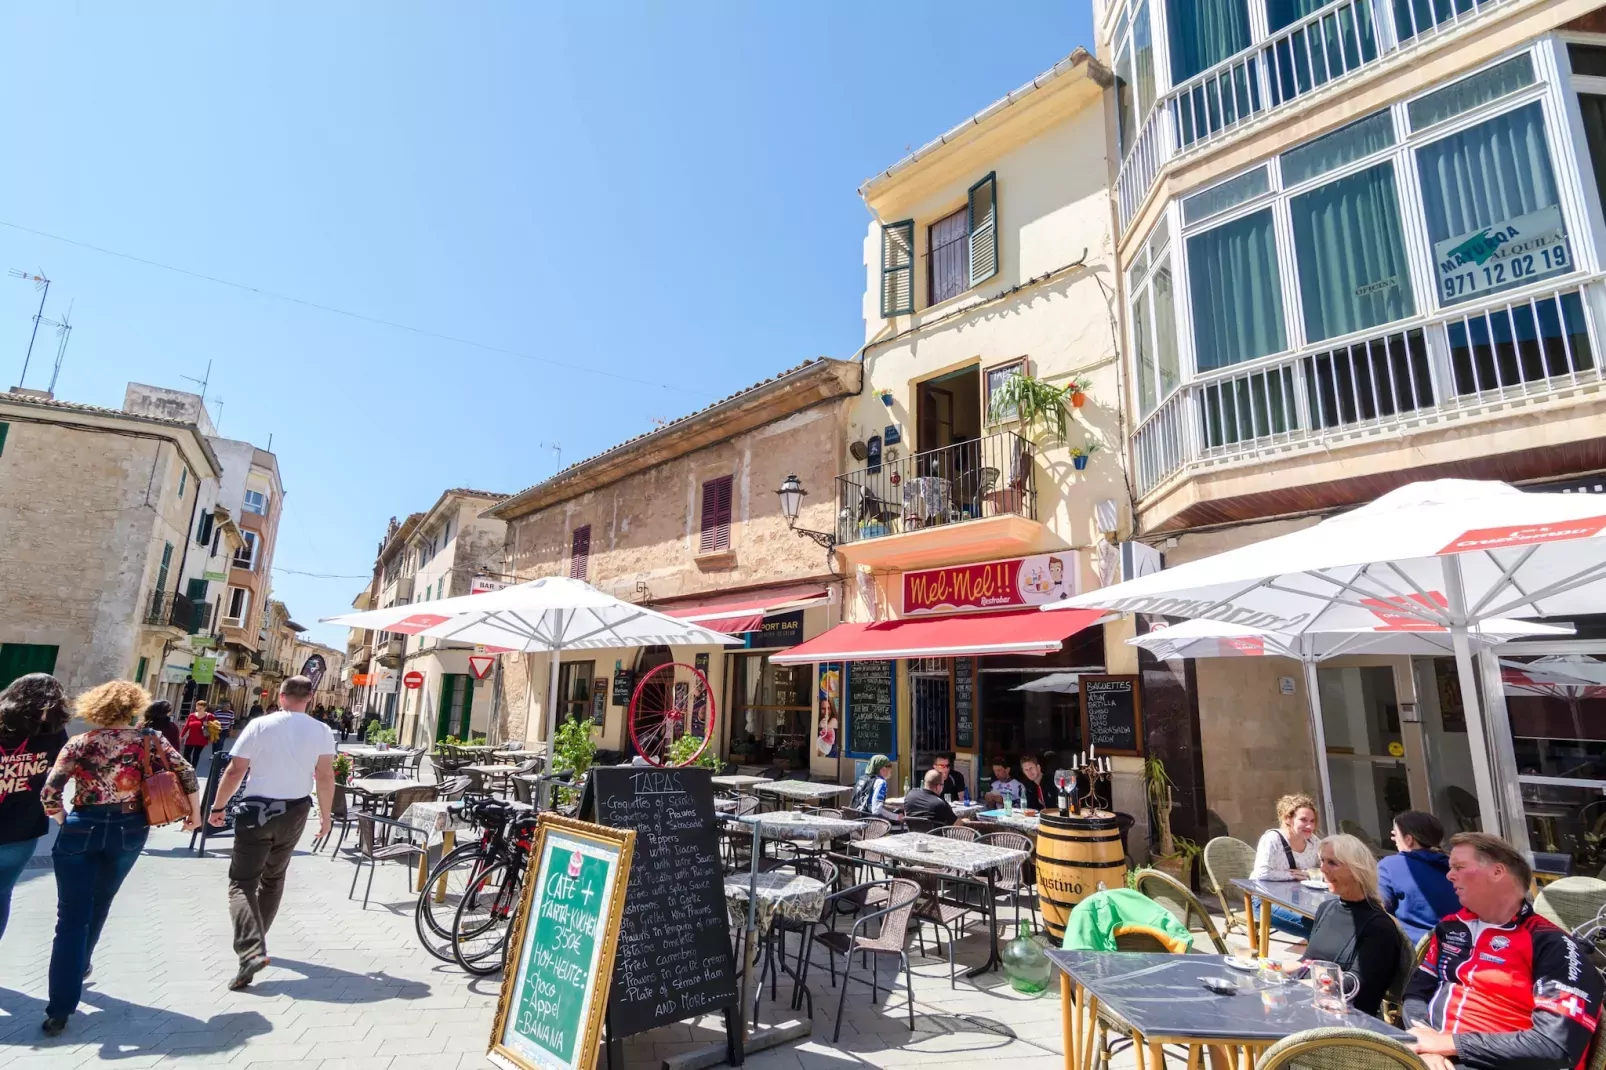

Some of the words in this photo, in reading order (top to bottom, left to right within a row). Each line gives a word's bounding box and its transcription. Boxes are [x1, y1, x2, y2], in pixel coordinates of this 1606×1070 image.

[1440, 225, 1520, 274] MAYURQA
[1491, 231, 1563, 261] ALQUILA
[1444, 271, 1476, 298] 971
[1483, 262, 1507, 287] 12
[1510, 254, 1536, 279] 02
[1541, 244, 1567, 270] 19
[480, 581, 495, 590] BAR
[781, 620, 799, 630] BAR
[1086, 681, 1132, 692] BAGUETTES
[1, 752, 34, 764] WASTE
[629, 772, 686, 794] TAPAS
[654, 796, 665, 813] of
[653, 808, 662, 822] of
[666, 807, 697, 820] Prawns
[654, 822, 663, 836] of
[647, 833, 680, 849] Peppers
[649, 847, 672, 858] with
[695, 852, 715, 864] Sauce
[689, 880, 711, 891] Sauce
[581, 880, 594, 906] +
[667, 895, 677, 907] in
[652, 926, 664, 938] in
[661, 968, 672, 980] in
[659, 982, 669, 998] of
[704, 967, 724, 982] Ham
[655, 1000, 677, 1017] AND
